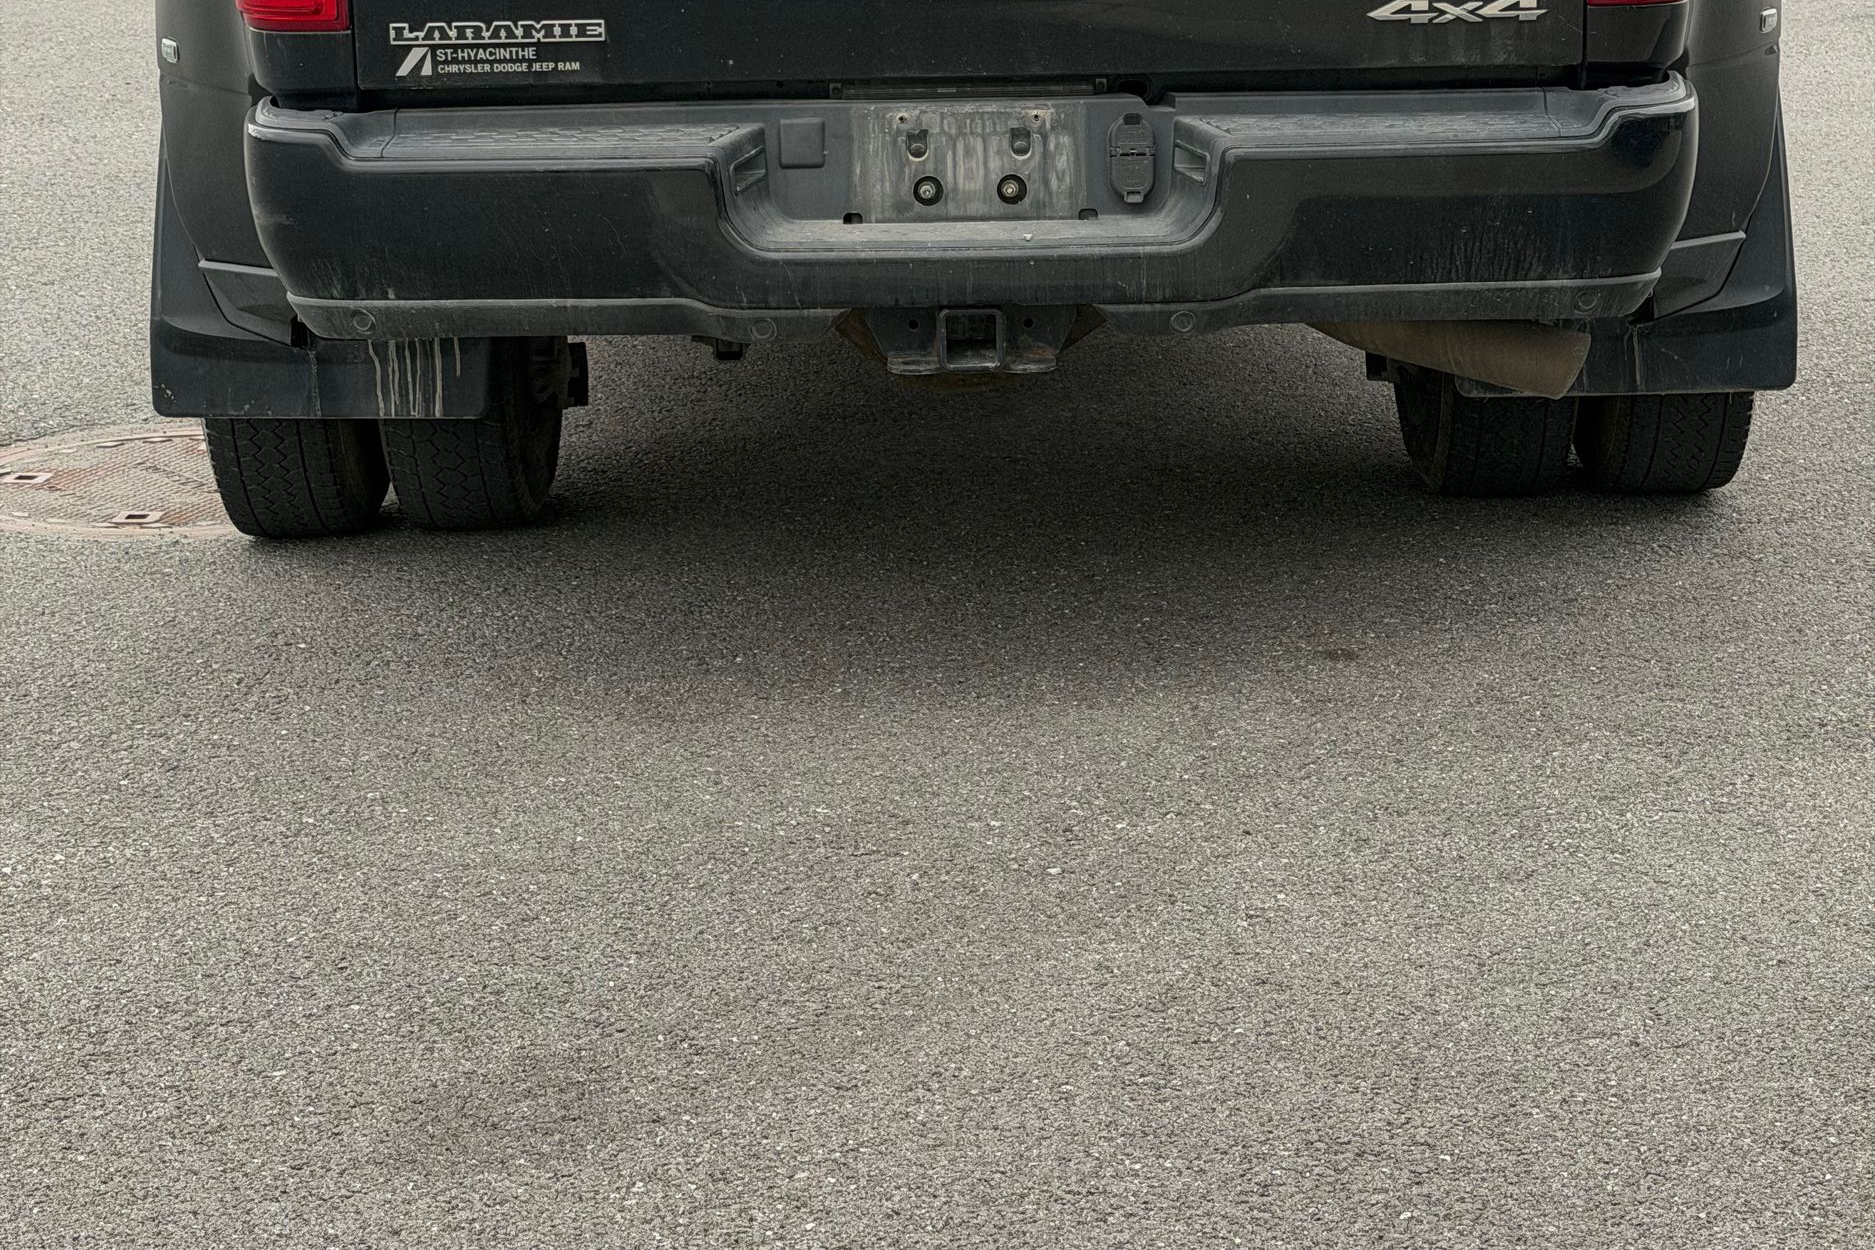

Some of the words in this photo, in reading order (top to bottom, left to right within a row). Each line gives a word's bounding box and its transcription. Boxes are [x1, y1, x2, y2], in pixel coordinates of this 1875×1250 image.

[389, 19, 605, 46] LARAMIE
[436, 47, 537, 62] ST-HYACINTHE
[437, 63, 490, 74] CHRYSLER
[493, 62, 529, 73] DODGE
[531, 61, 556, 72] JEEP
[558, 61, 581, 71] RAM
